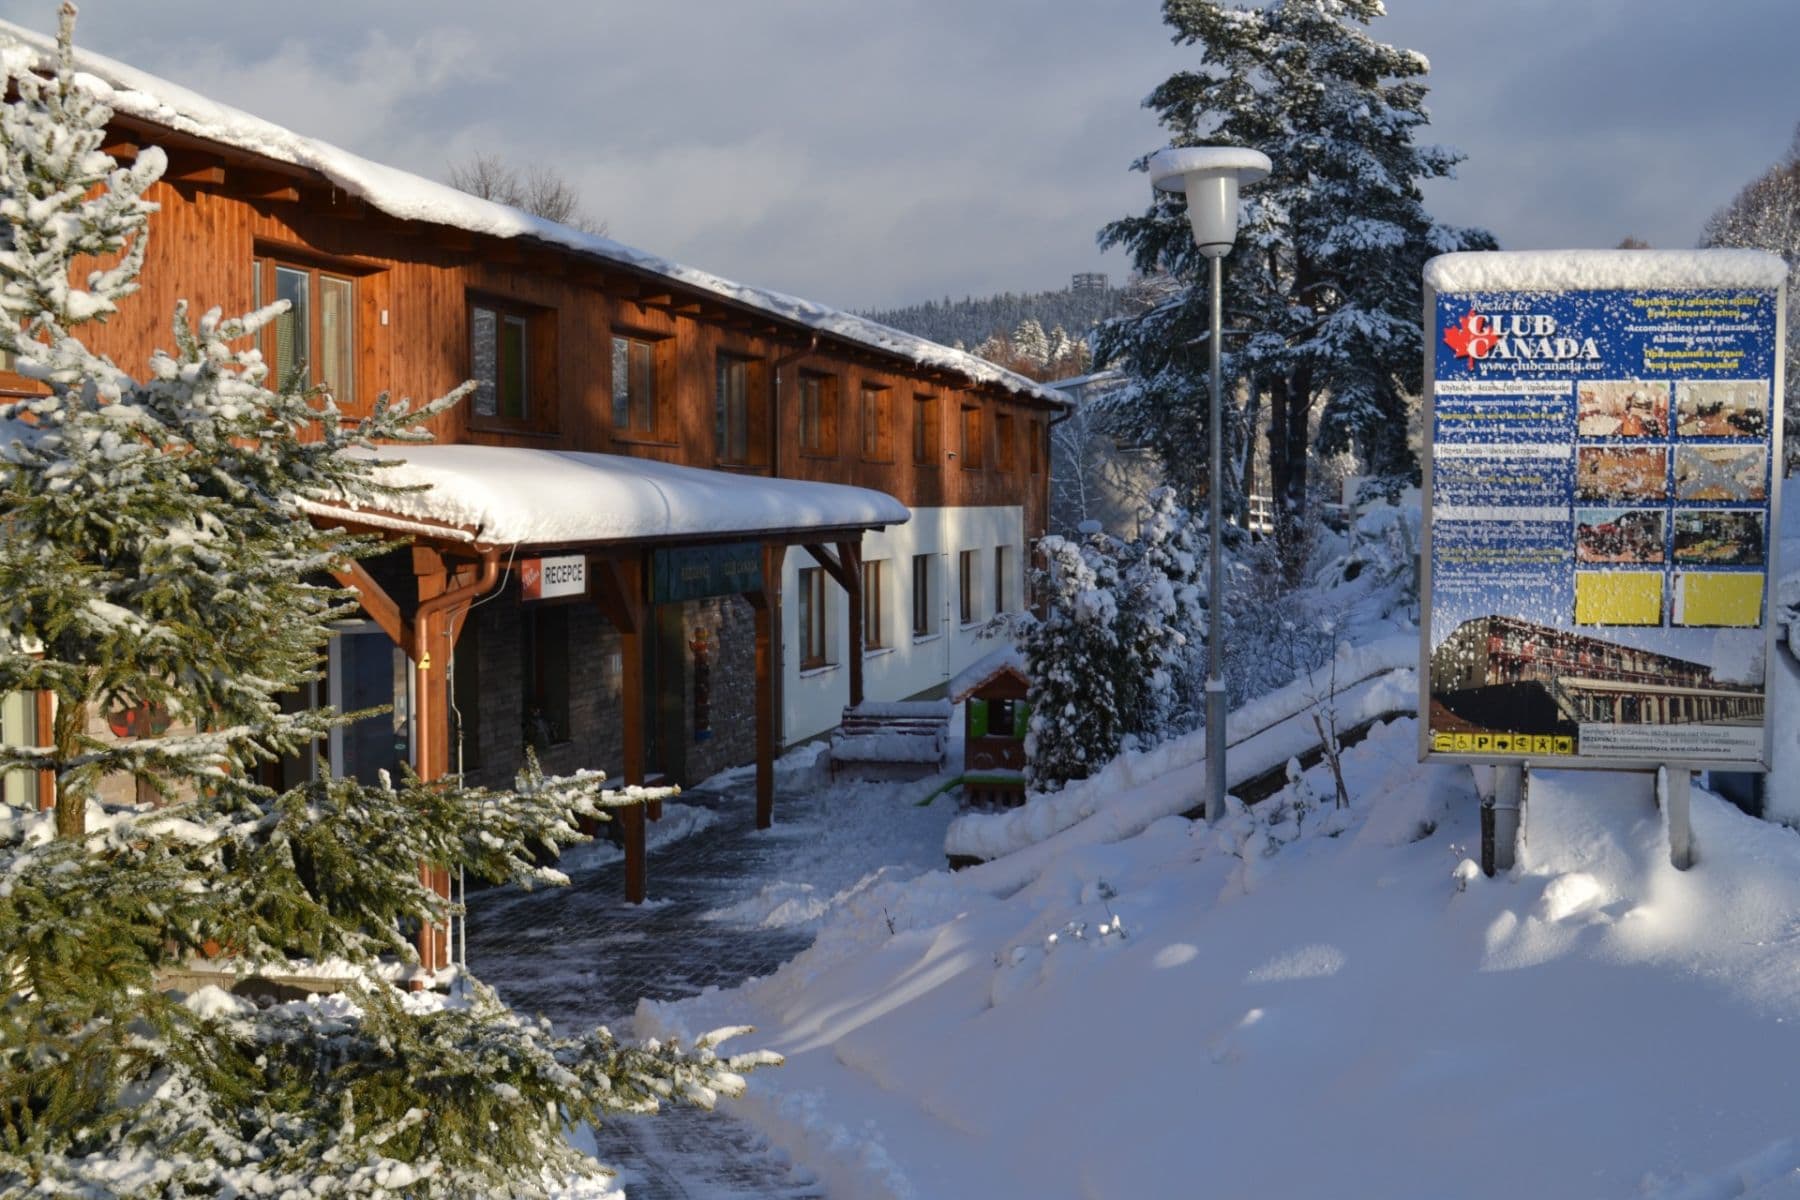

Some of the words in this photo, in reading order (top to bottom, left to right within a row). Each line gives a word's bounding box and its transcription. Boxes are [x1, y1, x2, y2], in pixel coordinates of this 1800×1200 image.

[1468, 314, 1556, 337] CLUB
[1467, 336, 1601, 360] CANADA
[545, 563, 583, 584] RECEPCE
